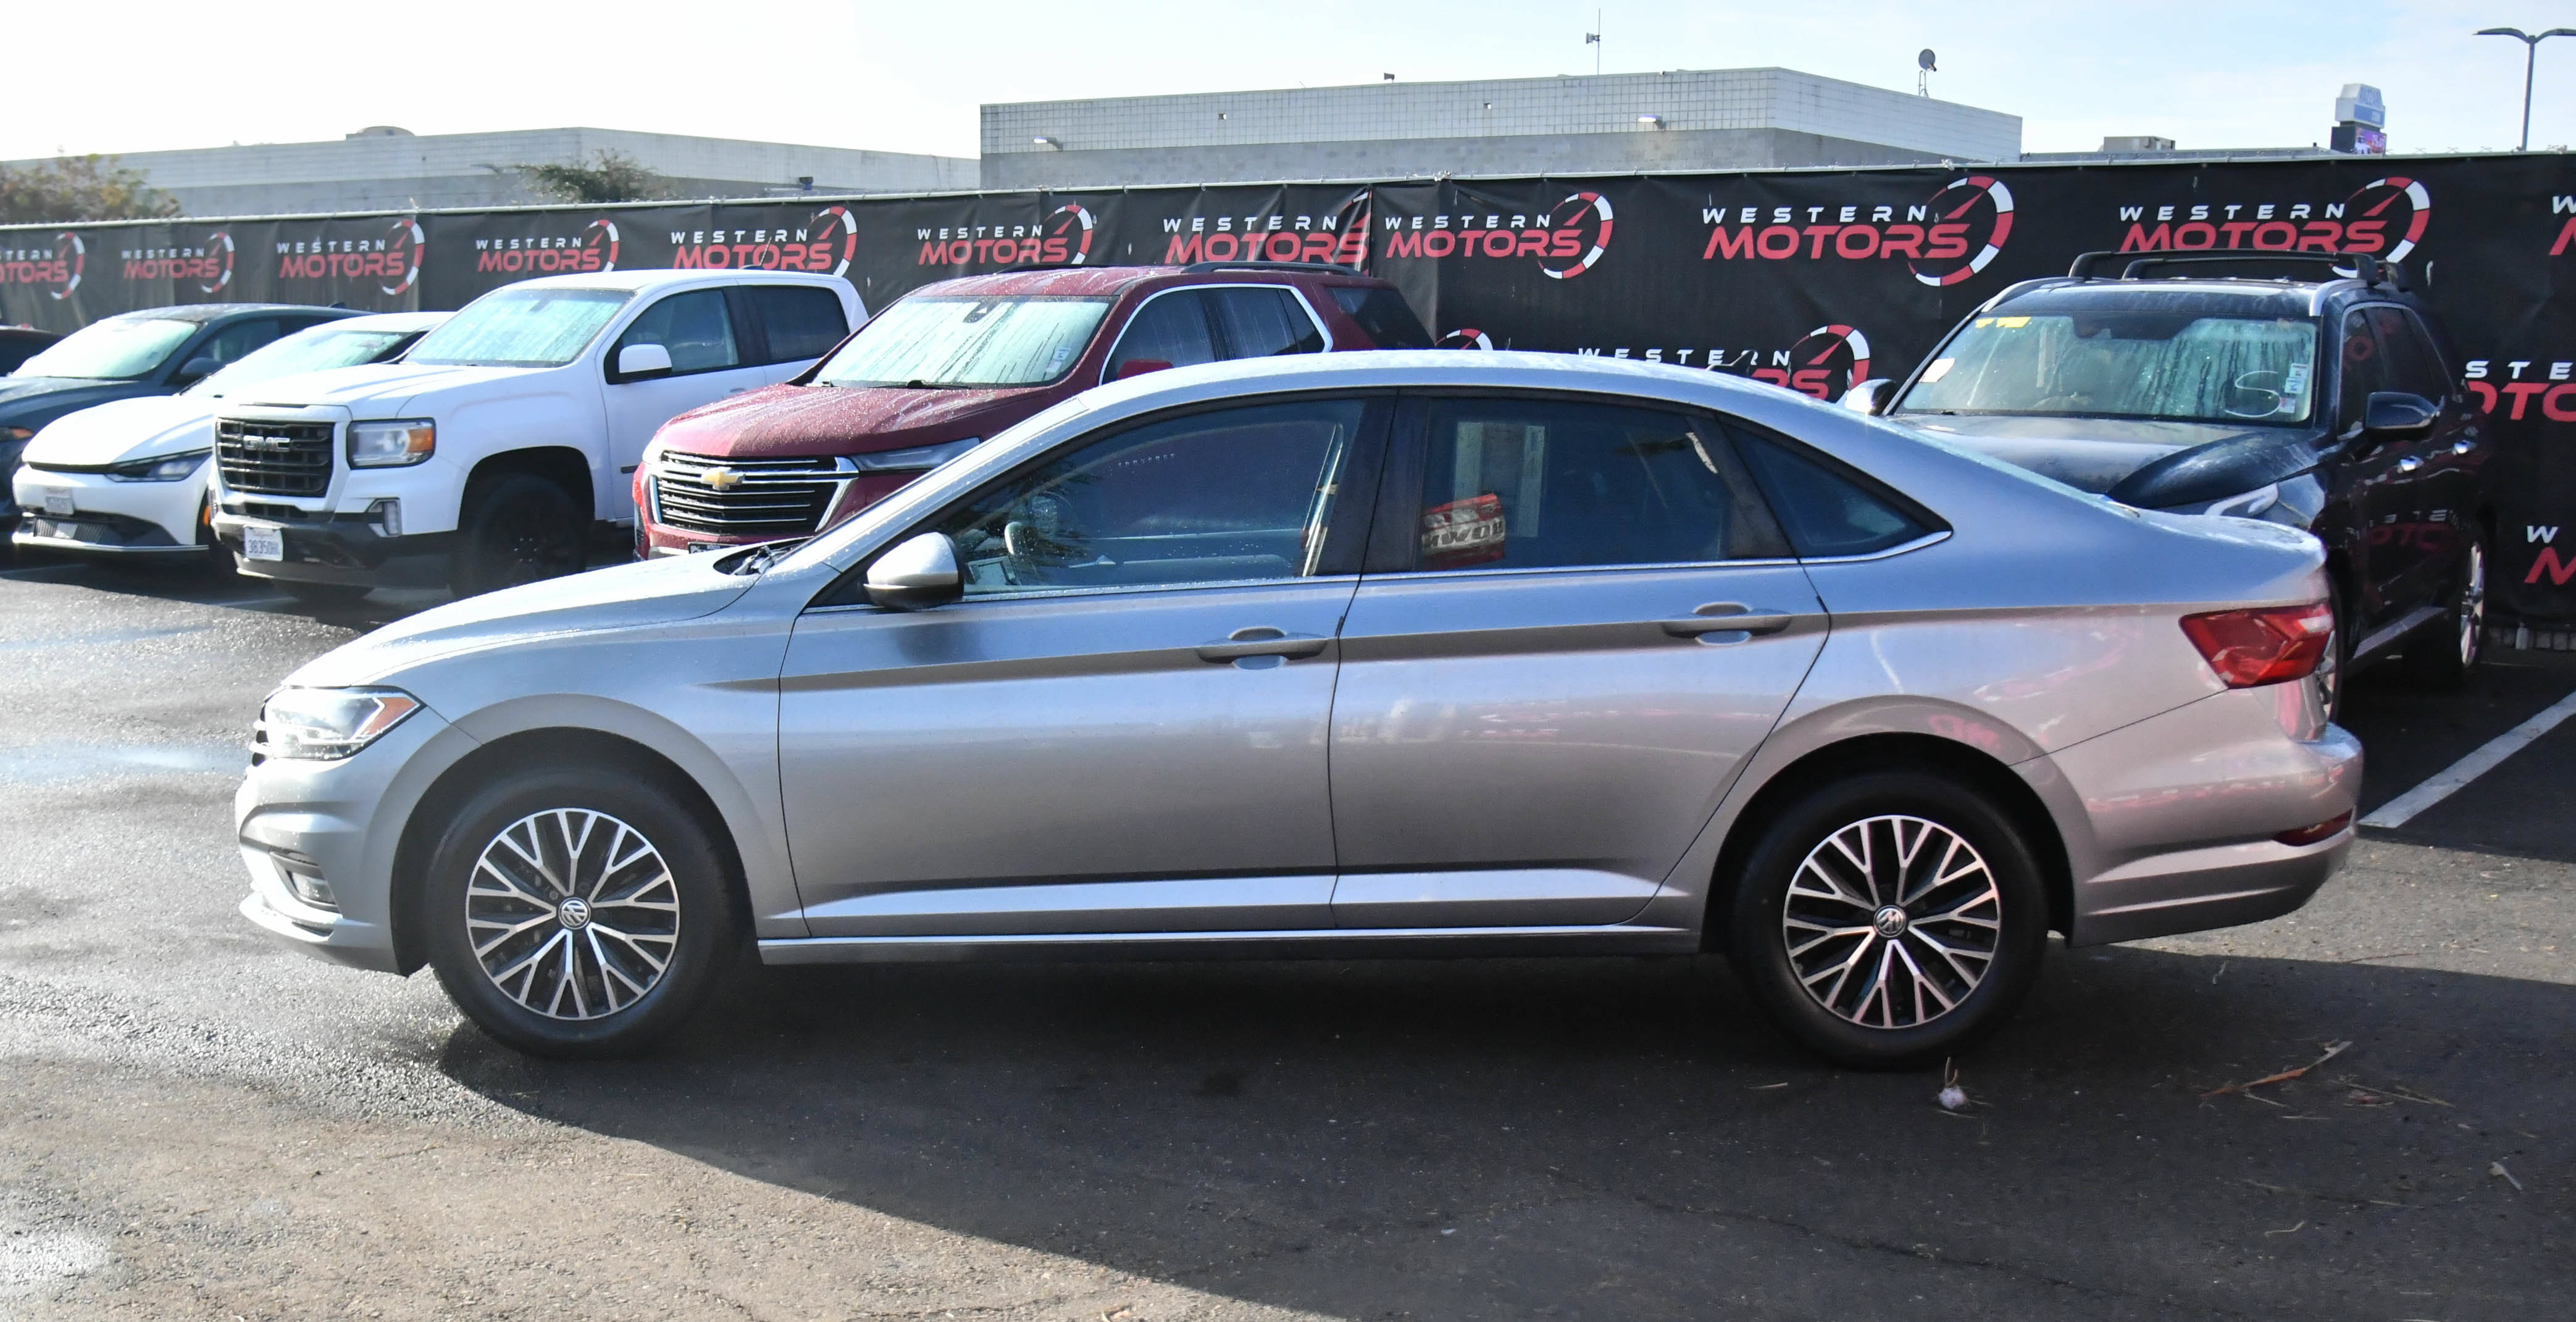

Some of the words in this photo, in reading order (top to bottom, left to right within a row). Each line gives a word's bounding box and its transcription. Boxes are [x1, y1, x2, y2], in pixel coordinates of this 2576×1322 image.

[1702, 206, 1926, 224] WESTERN
[2120, 203, 2344, 221] WESTERN
[1163, 215, 1337, 233] WESTERN
[1385, 214, 1551, 230] WESTERN
[671, 229, 808, 245] WESTERN
[918, 225, 1042, 240] WESTERN
[1703, 224, 1970, 259] MOTORS
[2120, 220, 2388, 252] MOTORS
[277, 239, 385, 254] WESTERN
[476, 237, 582, 250] WESTERN
[919, 238, 1068, 266] MOTORS
[1165, 232, 1368, 264] MOTORS
[1386, 228, 1583, 258] MOTORS
[121, 248, 205, 259] WESTERN
[478, 248, 601, 272] MOTORS
[673, 243, 832, 270] MOTORS
[125, 258, 220, 280] MOTORS
[280, 253, 405, 279] MOTORS
[1578, 348, 1790, 366] WESTERN
